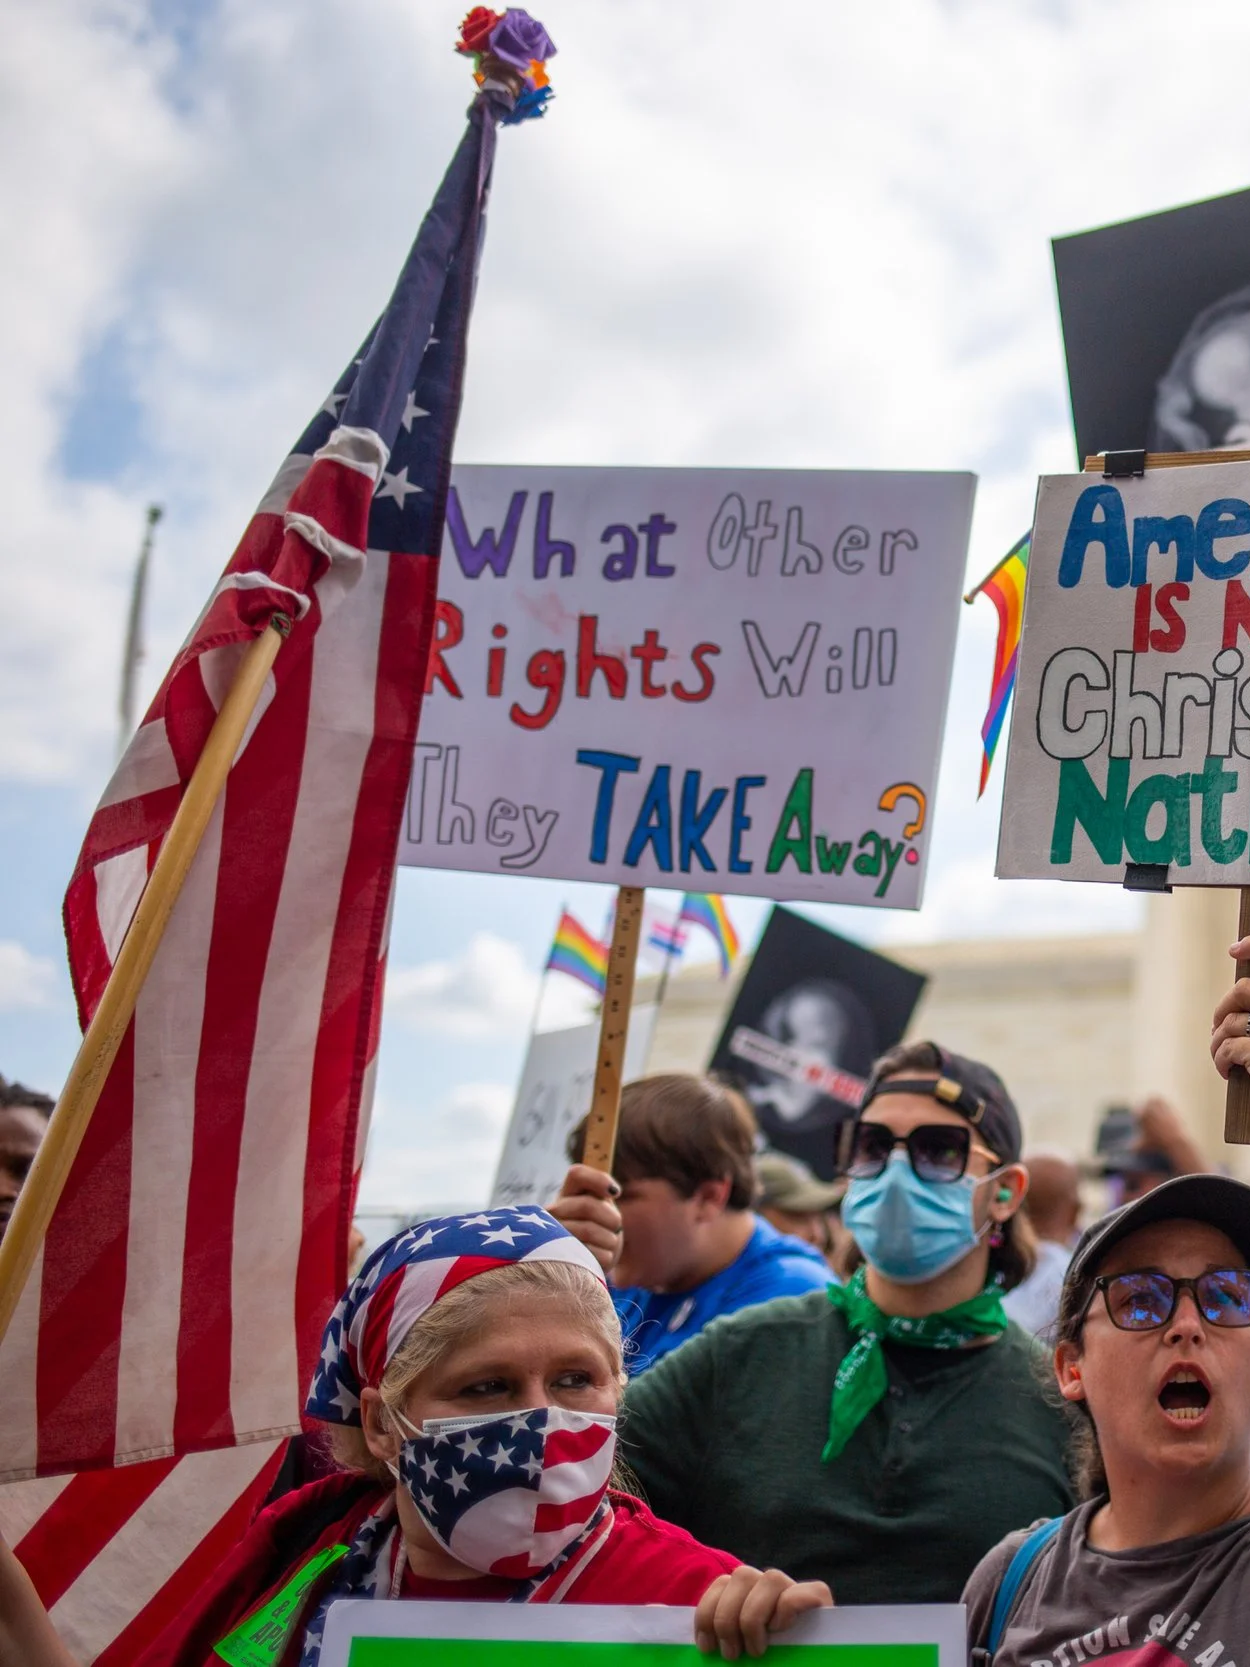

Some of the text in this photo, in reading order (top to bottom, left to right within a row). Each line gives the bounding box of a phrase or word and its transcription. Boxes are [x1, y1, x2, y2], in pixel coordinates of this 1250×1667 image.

[445, 486, 918, 581] What Other
[423, 600, 897, 730] Rights Will
[1132, 581, 1190, 653] IS
[405, 742, 559, 868] They
[576, 749, 767, 874] TAKE
